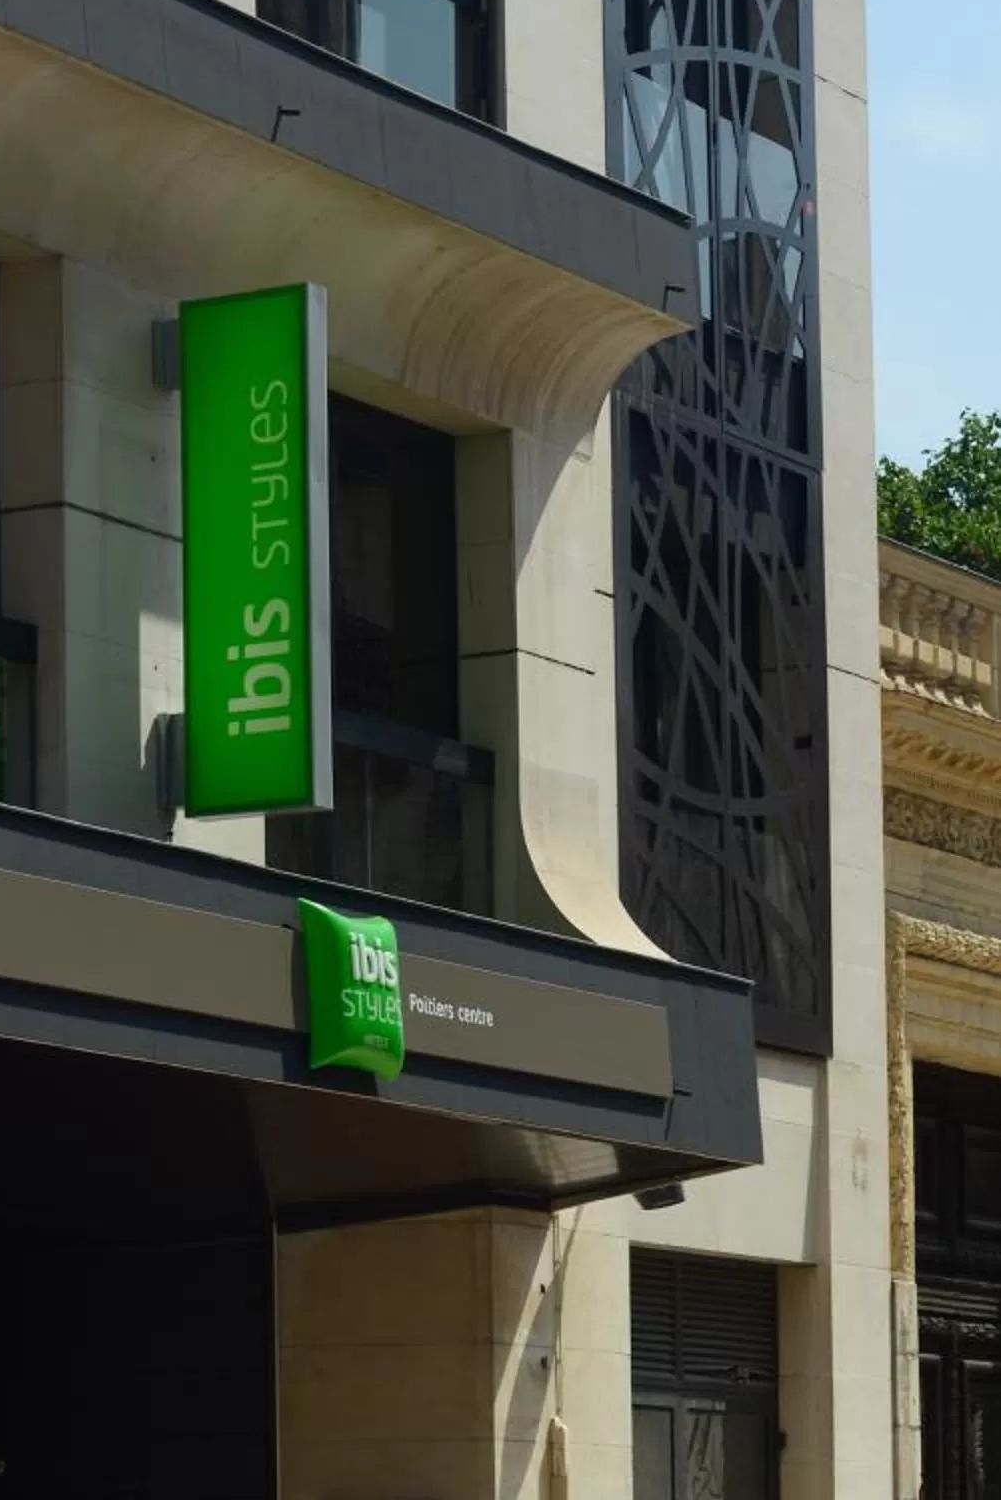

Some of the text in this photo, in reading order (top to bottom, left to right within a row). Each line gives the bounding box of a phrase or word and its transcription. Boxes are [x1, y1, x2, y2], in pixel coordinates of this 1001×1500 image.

[227, 596, 292, 737] ibis
[349, 931, 398, 988] ibis
[409, 992, 495, 1027] Poitiers centre
